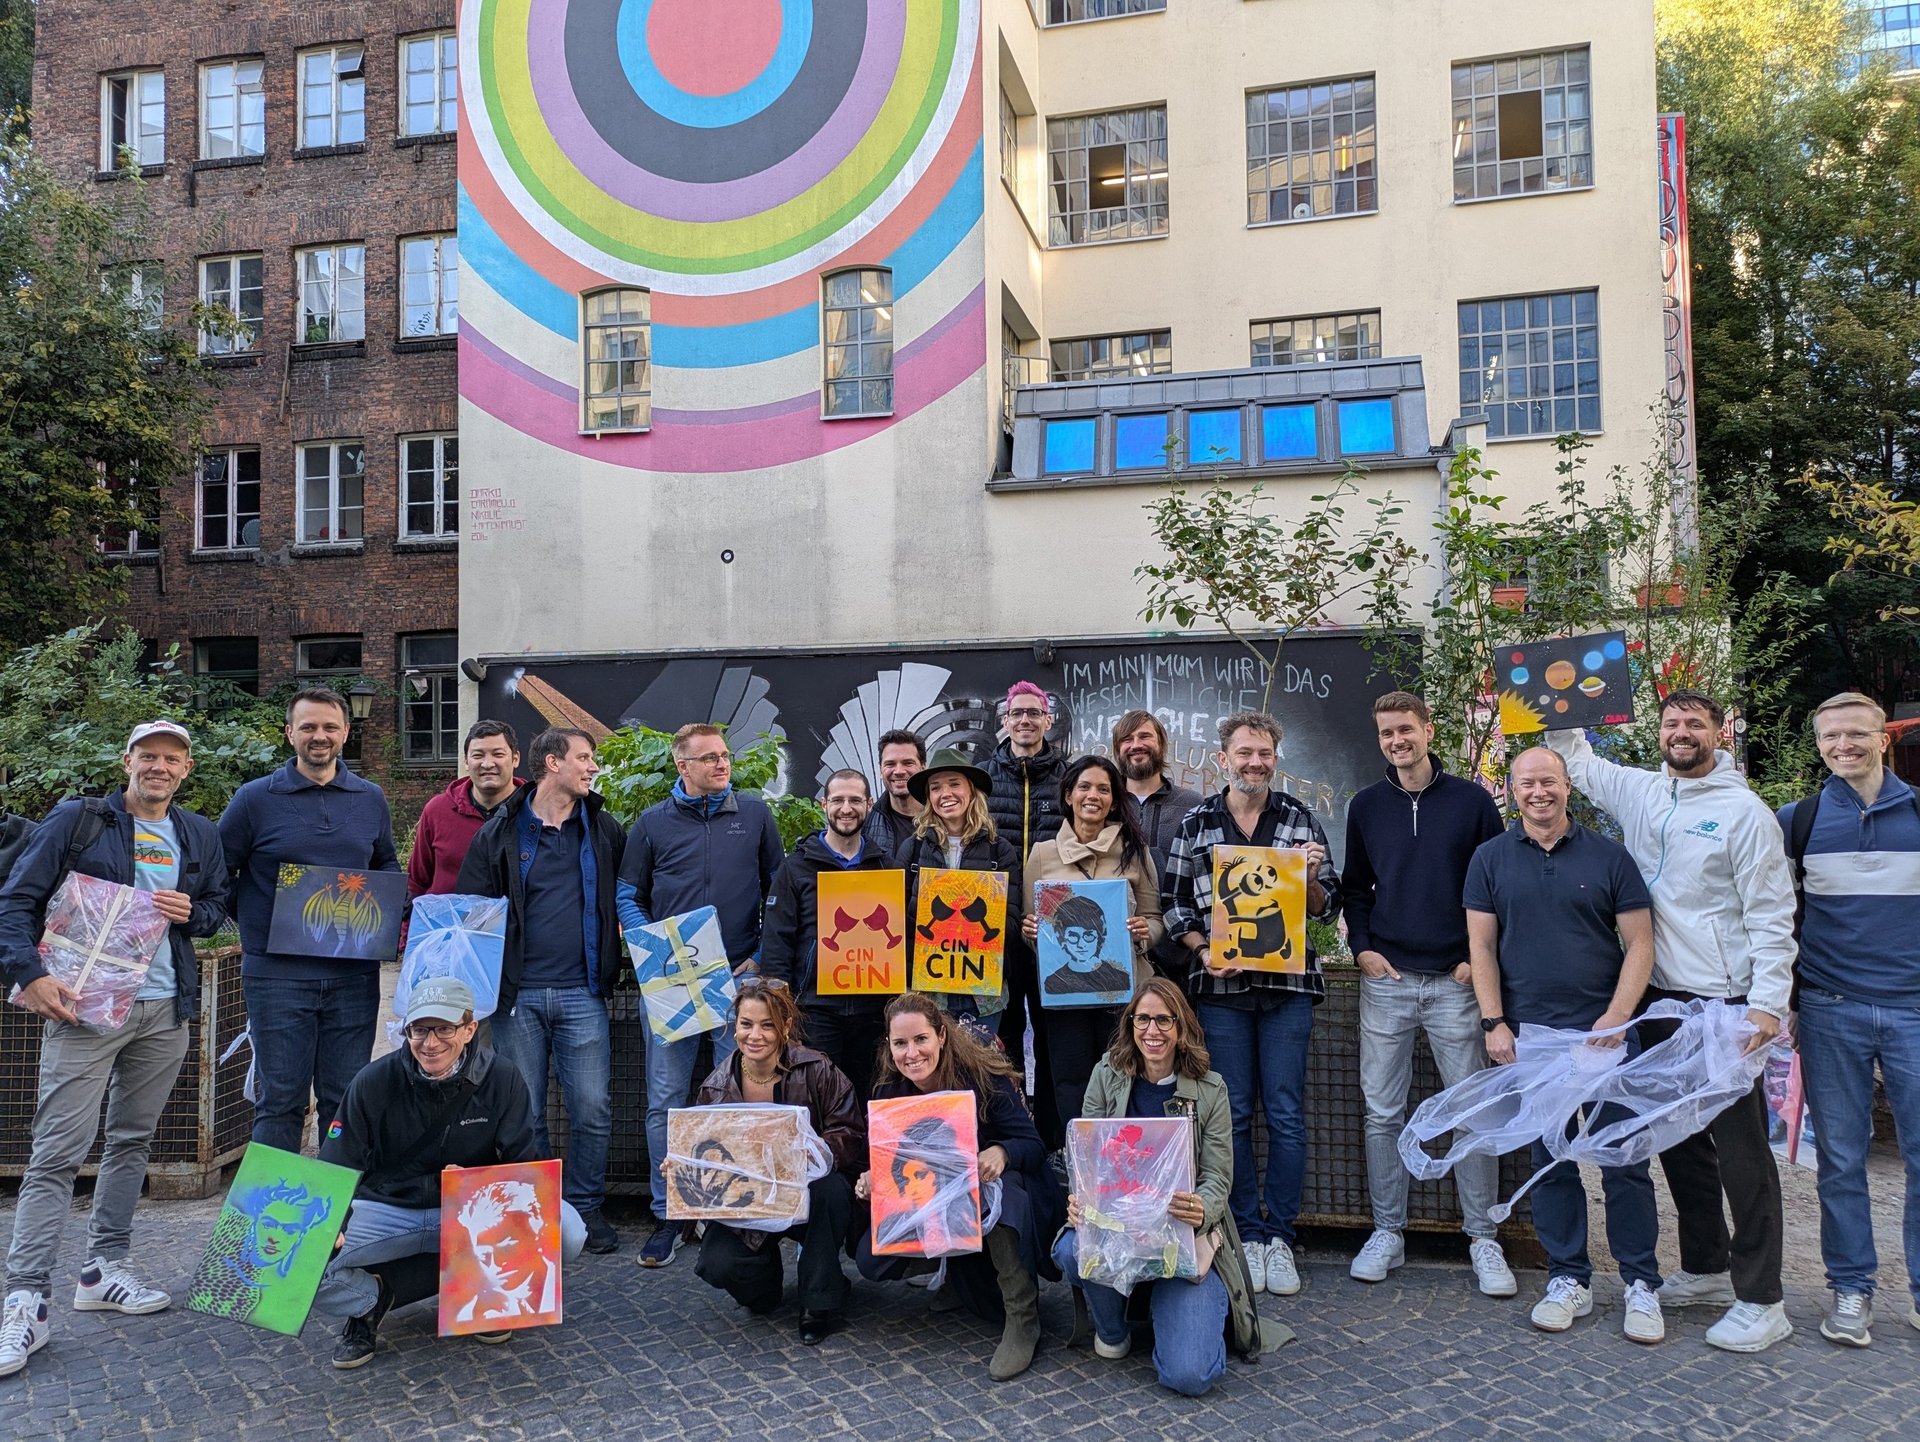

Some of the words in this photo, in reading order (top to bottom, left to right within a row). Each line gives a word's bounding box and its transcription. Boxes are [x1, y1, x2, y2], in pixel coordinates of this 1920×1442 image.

[1064, 663, 1092, 689] IM
[1283, 663, 1333, 699] DAS
[1696, 831, 1723, 842] balance
[940, 938, 969, 953] CIN
[845, 947, 874, 963] CIN
[926, 953, 985, 981] CIN
[832, 961, 891, 990] CIN
[465, 1116, 489, 1125] Columbia
